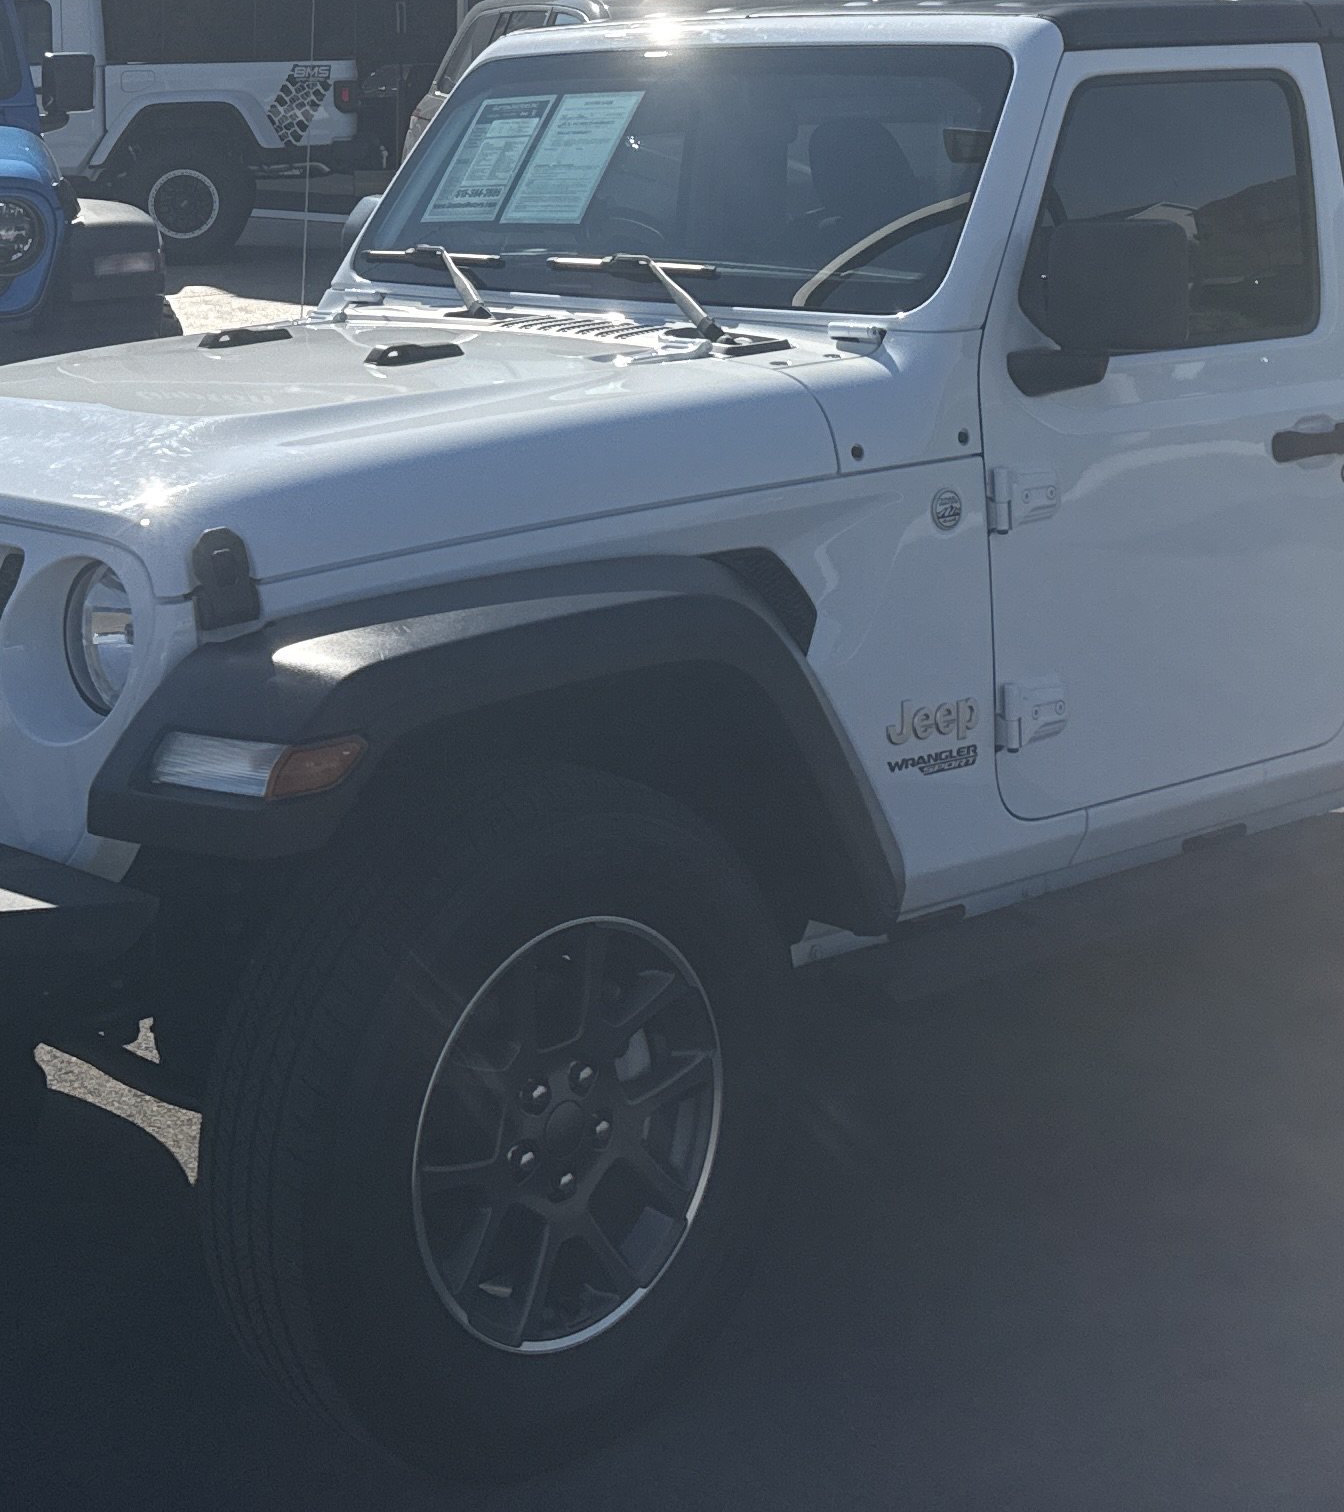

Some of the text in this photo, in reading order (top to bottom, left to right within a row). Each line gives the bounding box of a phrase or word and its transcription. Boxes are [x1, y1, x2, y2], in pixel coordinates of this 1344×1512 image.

[293, 66, 330, 78] BMS
[886, 697, 980, 745] Jeep
[887, 744, 978, 773] WRANGLER
[922, 756, 976, 775] SPORT
